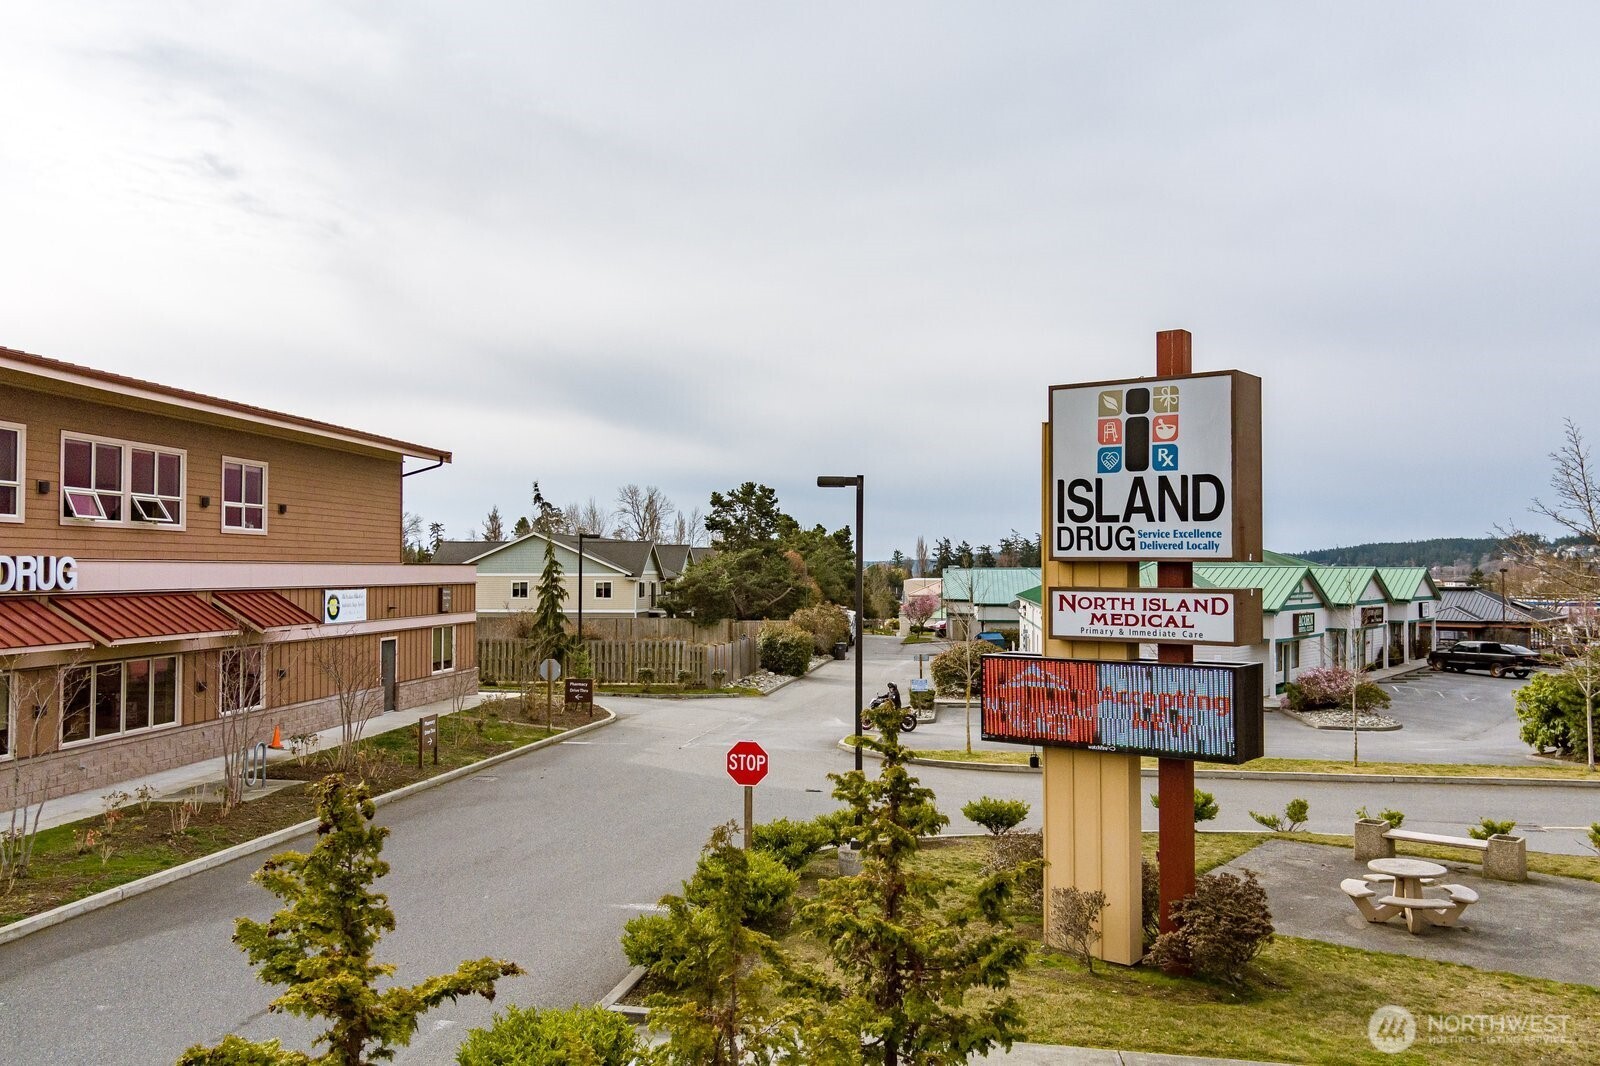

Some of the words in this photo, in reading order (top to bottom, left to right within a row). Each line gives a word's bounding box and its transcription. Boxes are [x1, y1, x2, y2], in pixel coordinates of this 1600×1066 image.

[1057, 474, 1226, 523] ISLAND
[1056, 525, 1136, 551] DRUG
[1137, 529, 1171, 539] Service
[1173, 528, 1222, 539] Excellence
[1140, 540, 1184, 550] Delivered
[1186, 540, 1220, 553] Locally
[0, 555, 78, 591] DRUG
[1089, 612, 1195, 629] MEDICAL
[1080, 627, 1114, 636] Primary
[1118, 628, 1125, 636] &
[1129, 629, 1176, 638] Immediate
[1182, 630, 1204, 639] Care
[1100, 685, 1230, 717] Accepting
[729, 753, 766, 771] STOP
